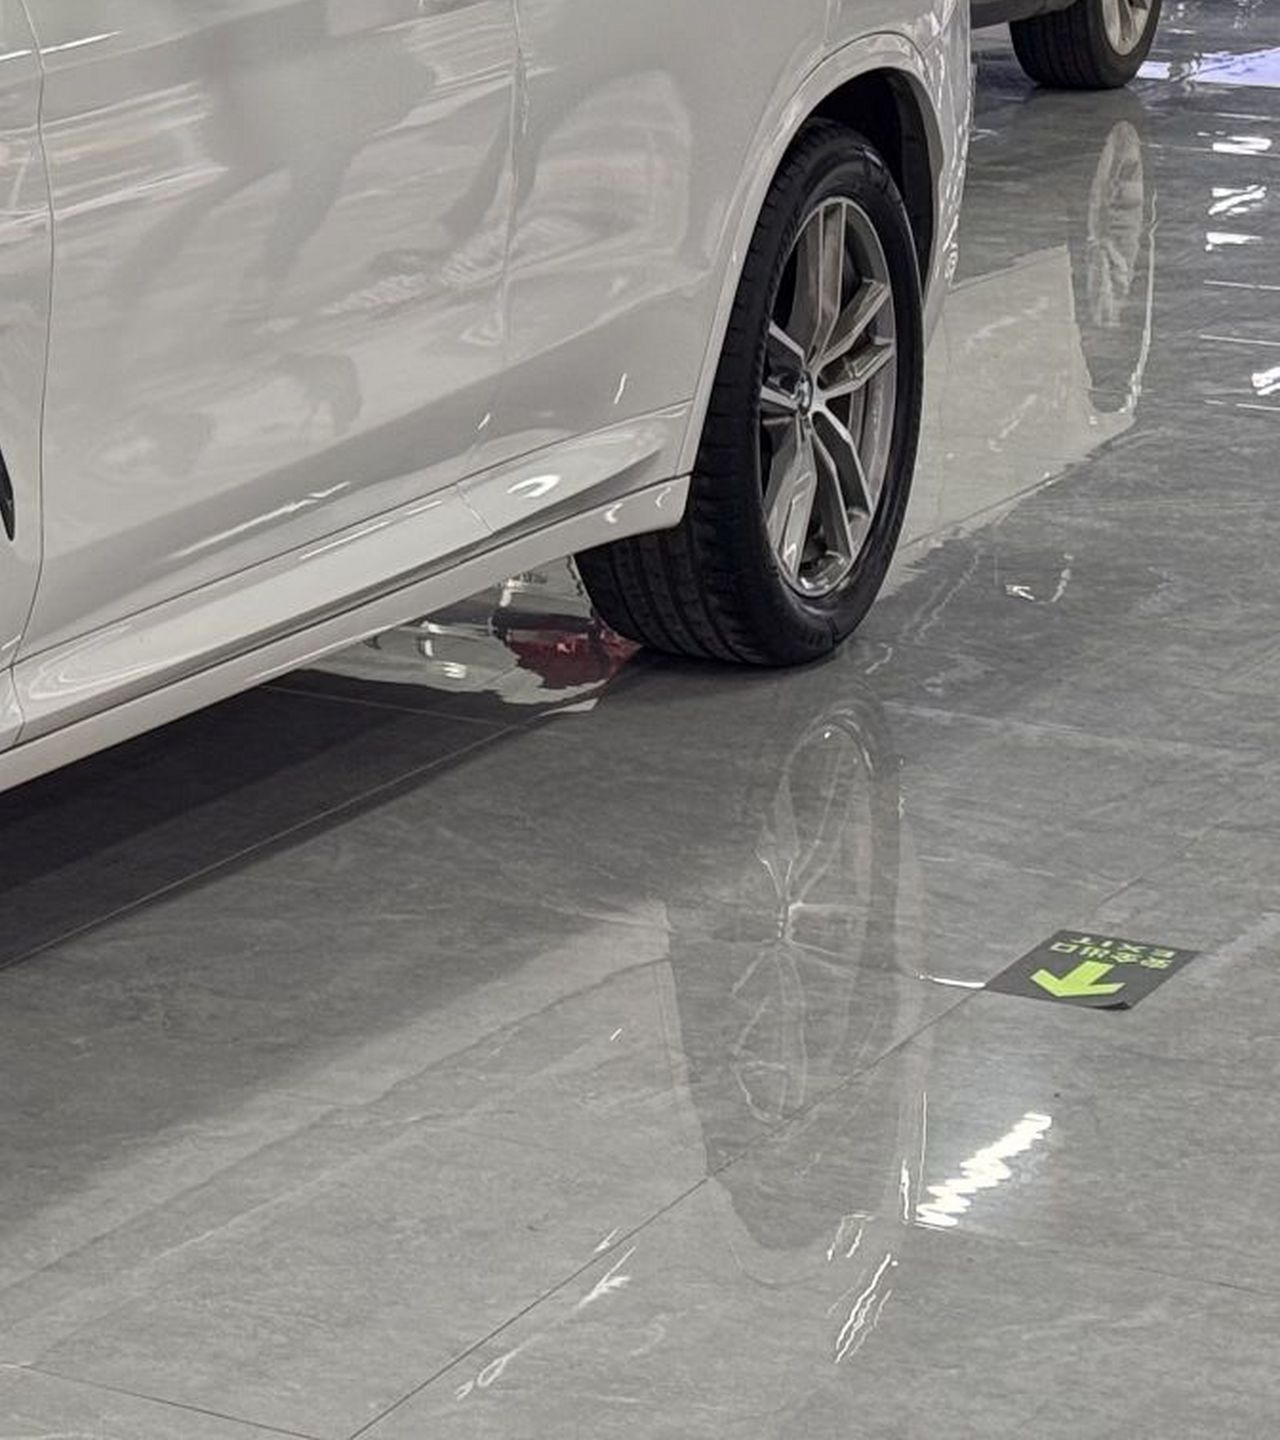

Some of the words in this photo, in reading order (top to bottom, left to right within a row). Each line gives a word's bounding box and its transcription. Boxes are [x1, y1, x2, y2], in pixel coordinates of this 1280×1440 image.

[1048, 941, 1173, 970] 安全出口
[1071, 937, 1175, 958] EXIT
